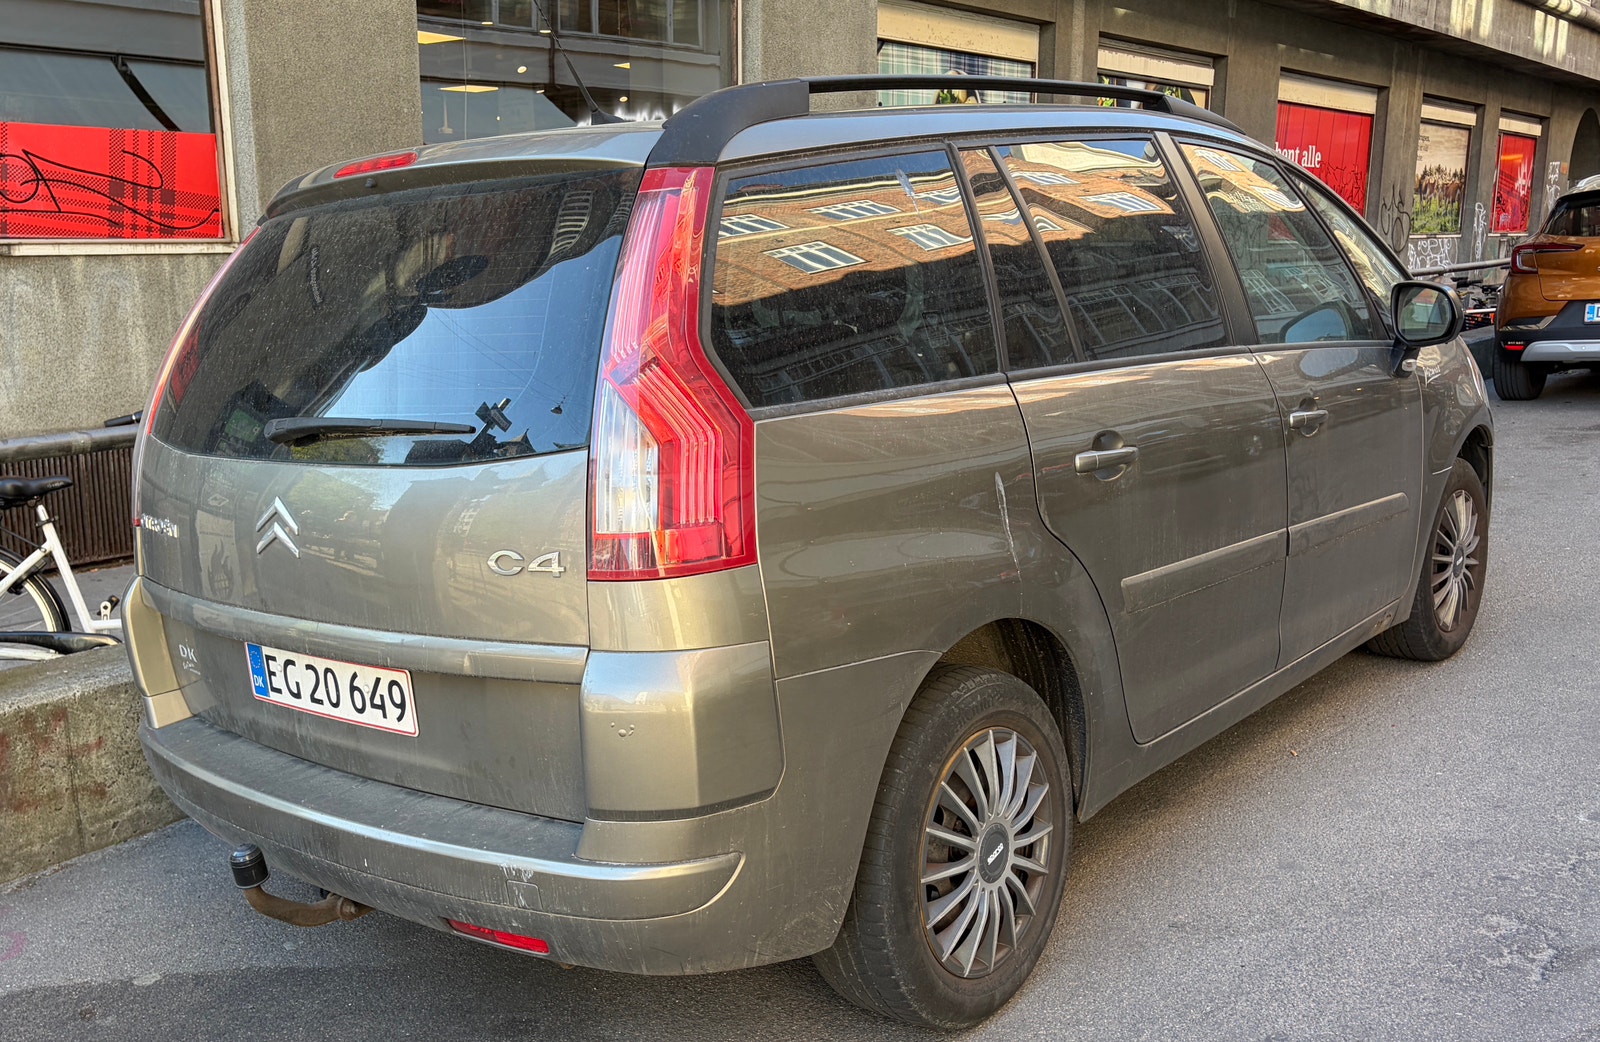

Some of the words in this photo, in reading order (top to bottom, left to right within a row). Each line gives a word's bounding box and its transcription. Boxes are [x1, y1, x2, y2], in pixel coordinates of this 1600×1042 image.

[1301, 145, 1322, 168] alle
[487, 549, 566, 578] C4
[254, 674, 265, 689] DK
[265, 654, 302, 700] EG
[305, 664, 341, 709] 20
[349, 671, 407, 723] 649
